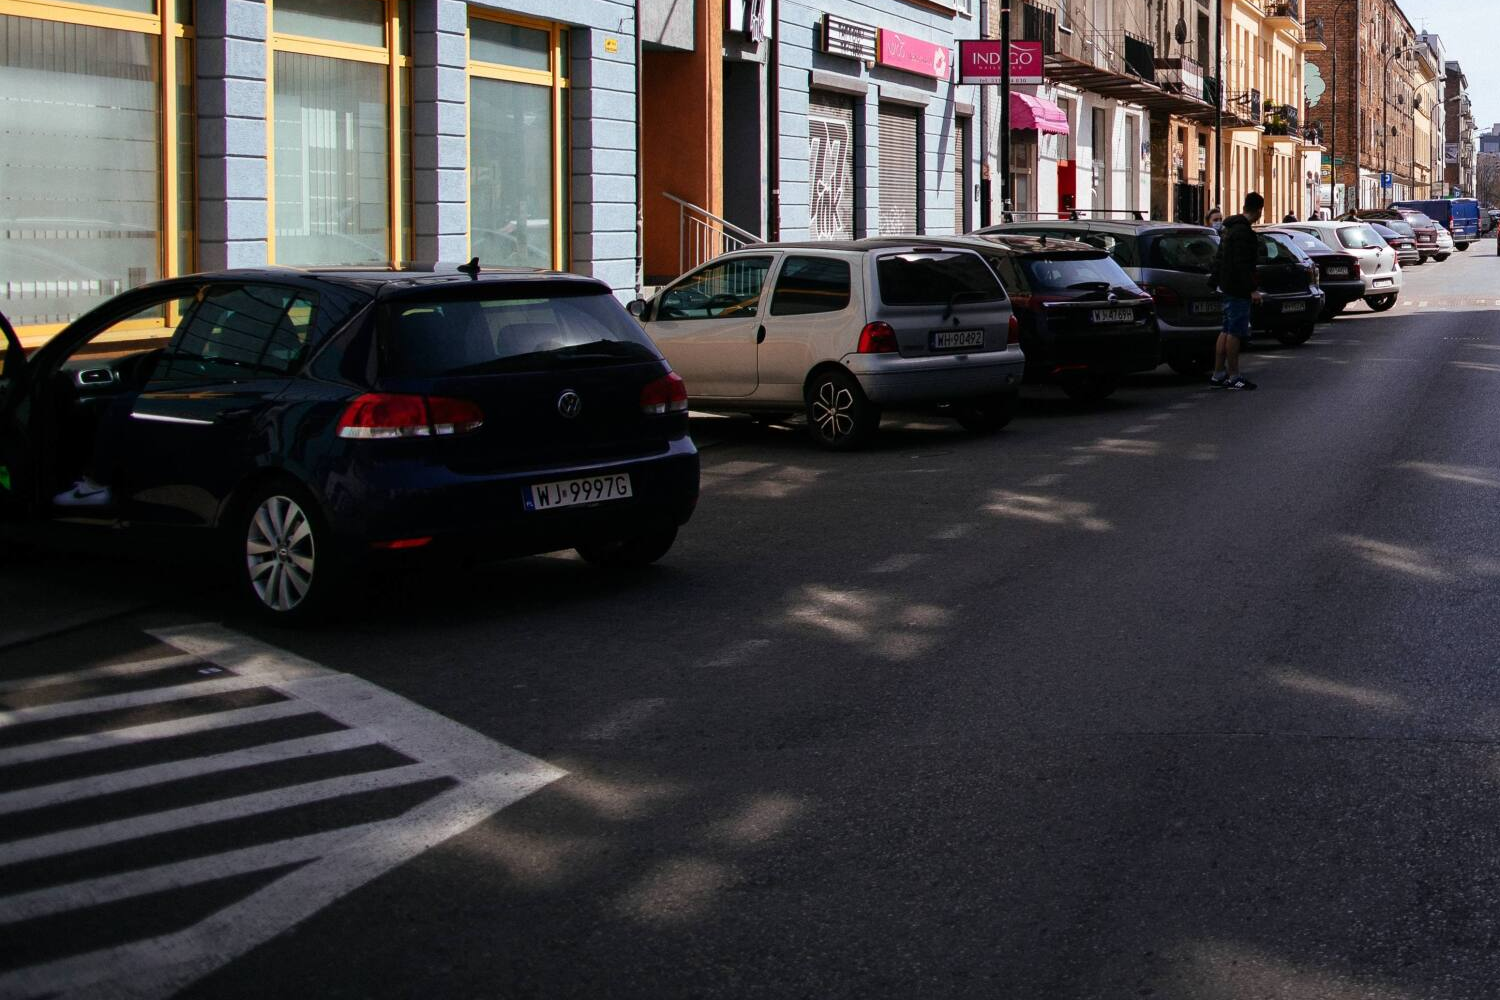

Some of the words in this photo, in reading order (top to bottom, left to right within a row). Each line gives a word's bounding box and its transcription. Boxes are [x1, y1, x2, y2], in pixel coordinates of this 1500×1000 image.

[973, 52, 1033, 65] INDGO
[938, 334, 951, 346] WH
[537, 484, 561, 507] WJ
[570, 476, 628, 502] 9997G
